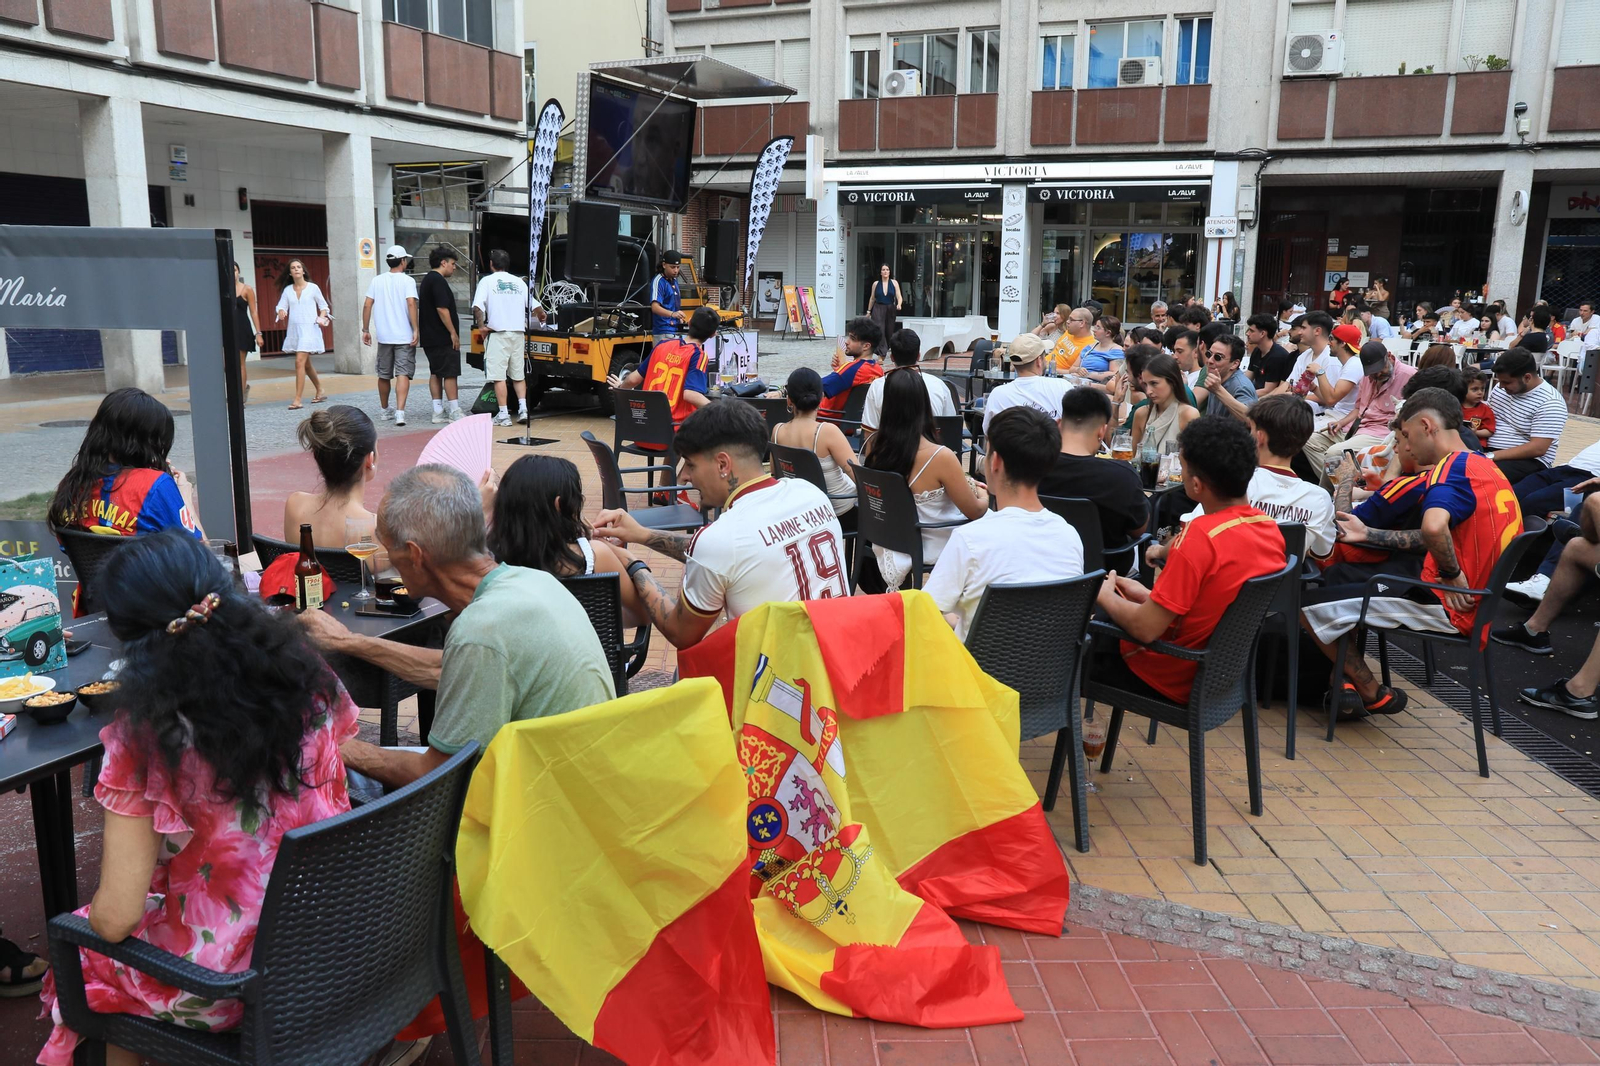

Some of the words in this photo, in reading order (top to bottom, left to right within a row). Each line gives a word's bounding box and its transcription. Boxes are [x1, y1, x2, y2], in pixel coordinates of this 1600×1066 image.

[984, 166, 1047, 176] VICTORIA
[863, 191, 915, 202] VICTORIA
[1056, 189, 1115, 200] VICTORIA
[0, 276, 67, 307] María
[648, 361, 684, 407] 20
[92, 499, 138, 533] YAMAL
[758, 516, 806, 546] LAMINE
[784, 528, 847, 599] 19
